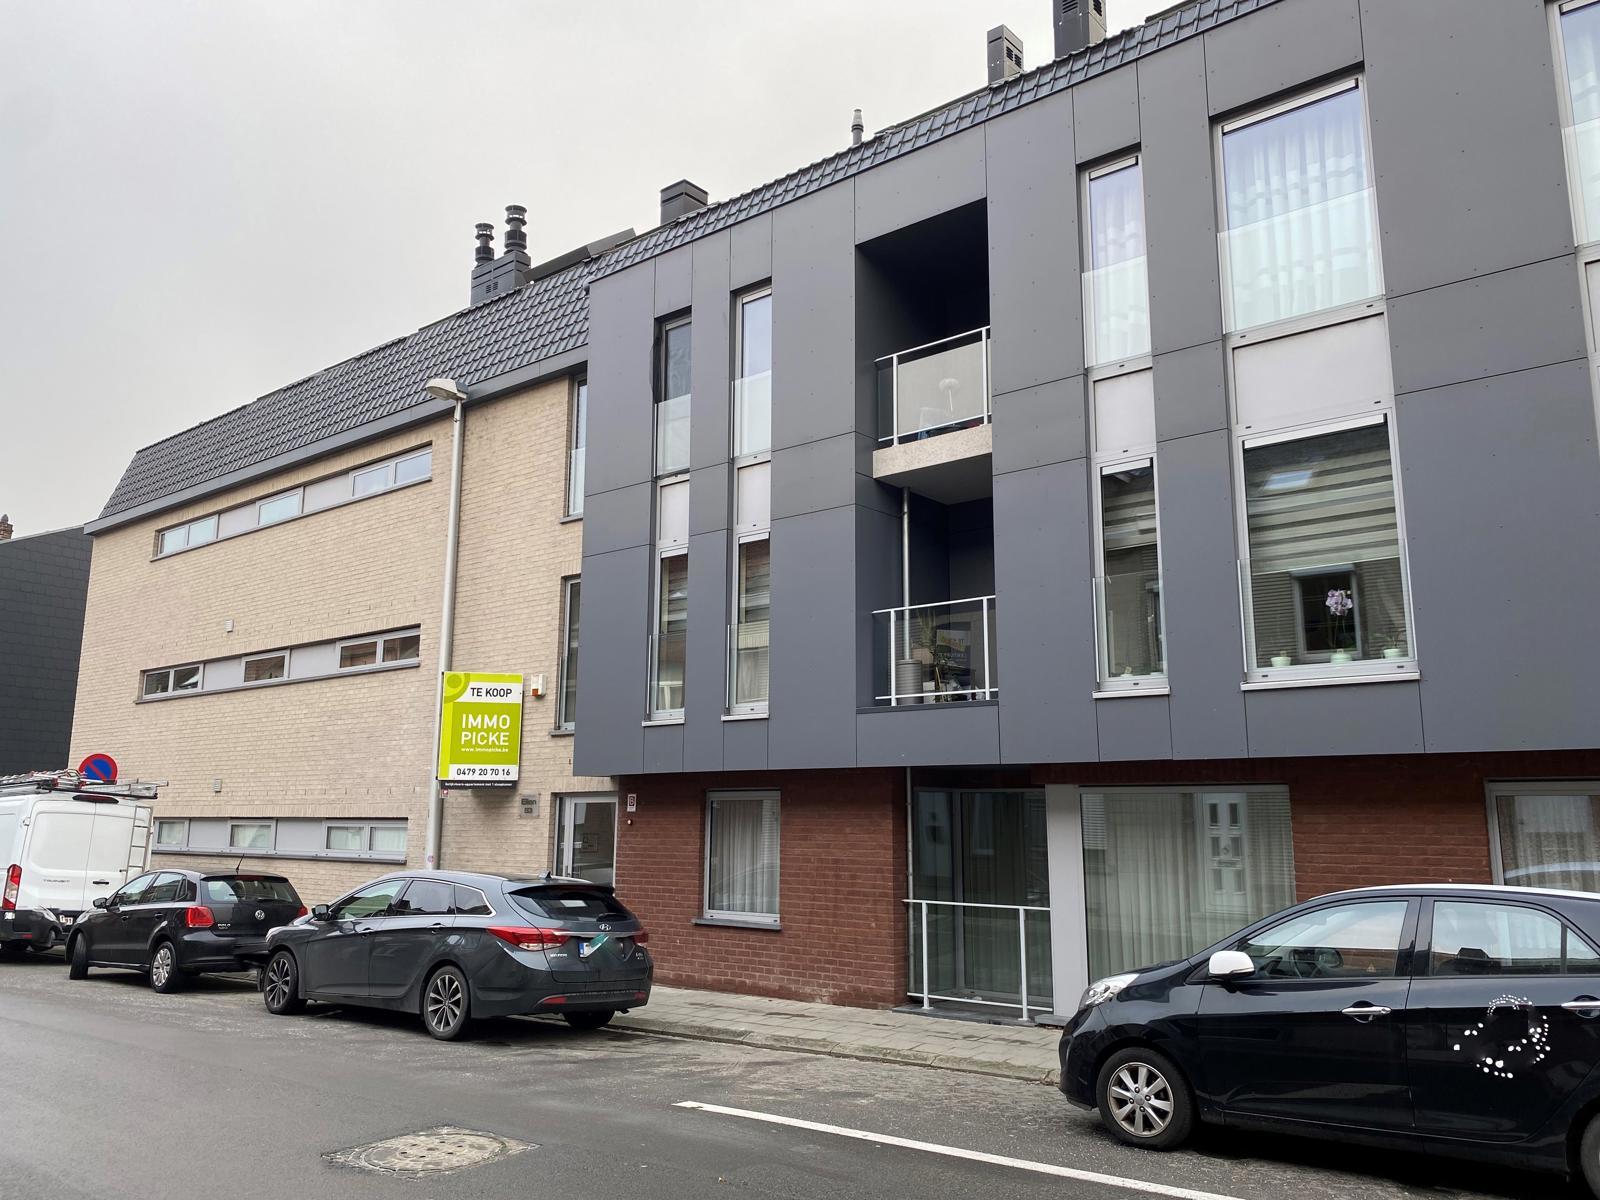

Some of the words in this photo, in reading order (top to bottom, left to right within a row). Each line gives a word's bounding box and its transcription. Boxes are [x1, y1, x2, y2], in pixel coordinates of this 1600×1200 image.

[470, 688, 482, 696] TE
[486, 688, 512, 698] KOOP
[462, 714, 510, 729] IMMO
[461, 732, 510, 746] PICKE
